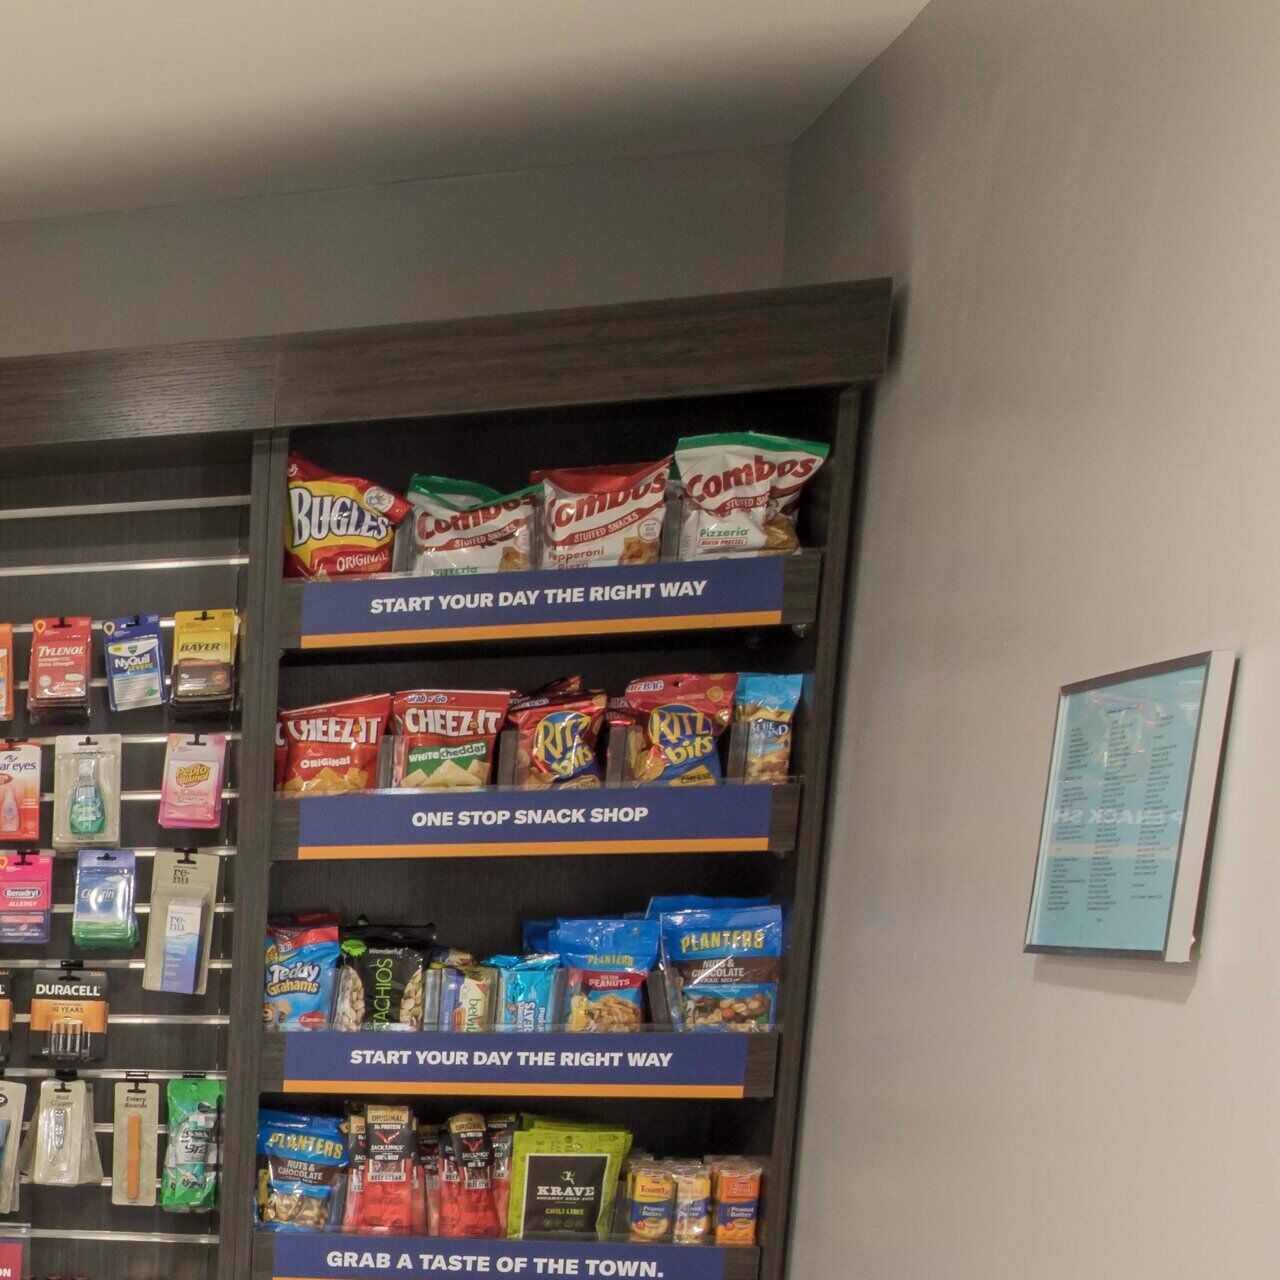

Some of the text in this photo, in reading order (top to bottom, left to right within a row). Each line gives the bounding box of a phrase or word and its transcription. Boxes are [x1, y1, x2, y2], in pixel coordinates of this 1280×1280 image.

[684, 455, 817, 502] Combos
[290, 487, 389, 546] BUGLES
[574, 512, 639, 543] STUFFED SNACKS
[700, 527, 749, 537] Pizzeria
[370, 580, 707, 614] START YOUR DAY THE RIGHT WAY
[38, 645, 84, 657] TYLENOL
[180, 643, 221, 652] BAYER
[114, 653, 150, 670] NyQuil
[128, 663, 153, 672] SEVERE
[651, 708, 707, 746] RITZ
[540, 718, 590, 760] RITZ
[664, 736, 714, 764] bits
[13, 762, 36, 772] eyes
[412, 807, 649, 827] ONE STOP SNACK SHOP
[6, 889, 39, 897] Benadryl
[681, 931, 764, 953] PLANTERS
[269, 962, 320, 981] Teddy
[36, 984, 100, 996] DURACELL
[267, 979, 320, 995] Grahams
[590, 978, 630, 987] PEANUTS
[374, 958, 393, 1031] TACHIOS
[350, 1050, 673, 1067] START YOUR DAY THE RIGHT WAY
[269, 1133, 343, 1160] PLANTERS
[536, 1186, 595, 1196] KRAVE
[326, 1251, 664, 1278] GRAB A TASTE OF THE TOWN.
